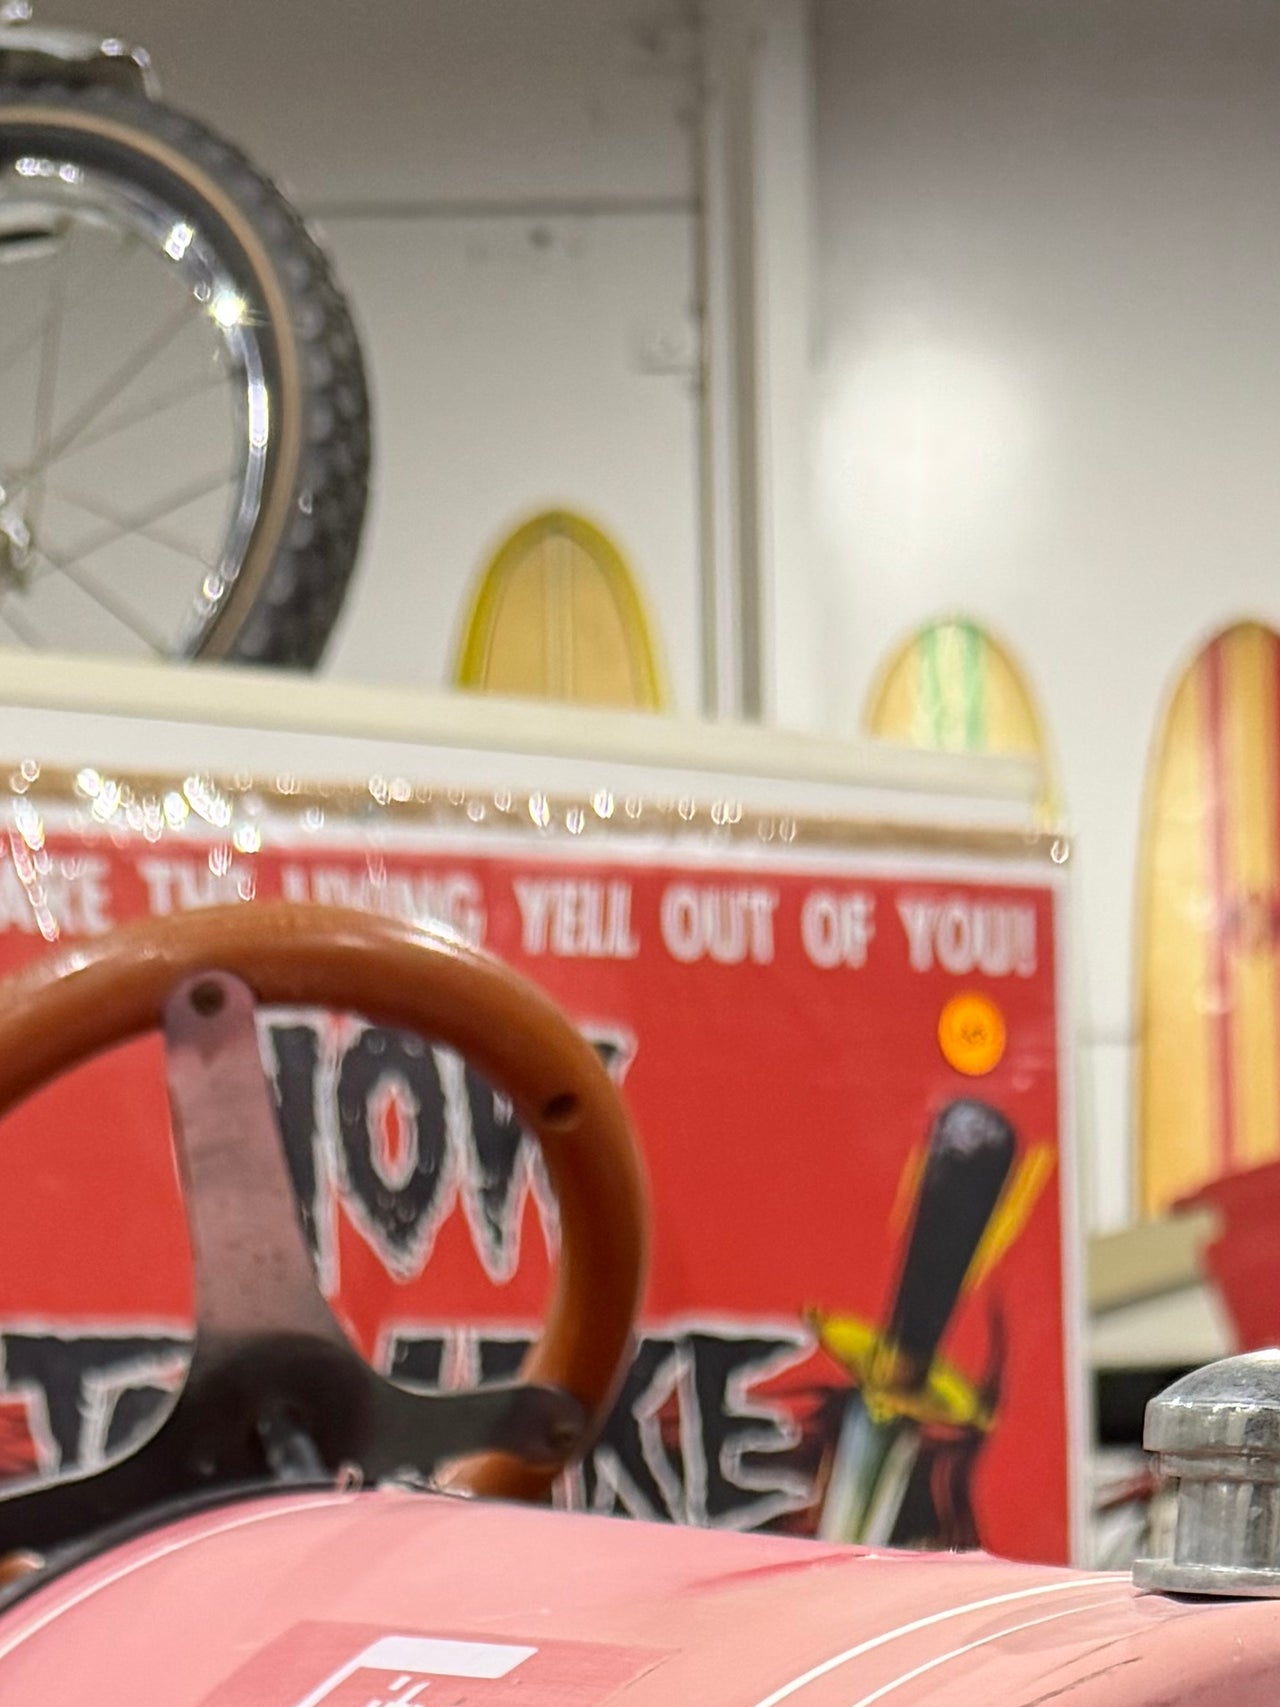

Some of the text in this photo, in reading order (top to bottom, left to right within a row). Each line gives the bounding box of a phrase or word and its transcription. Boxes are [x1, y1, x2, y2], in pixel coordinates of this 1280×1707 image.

[513, 878, 641, 960] YELL
[659, 882, 780, 965] OUT
[801, 889, 876, 970] OF
[894, 896, 1038, 979] YOU!
